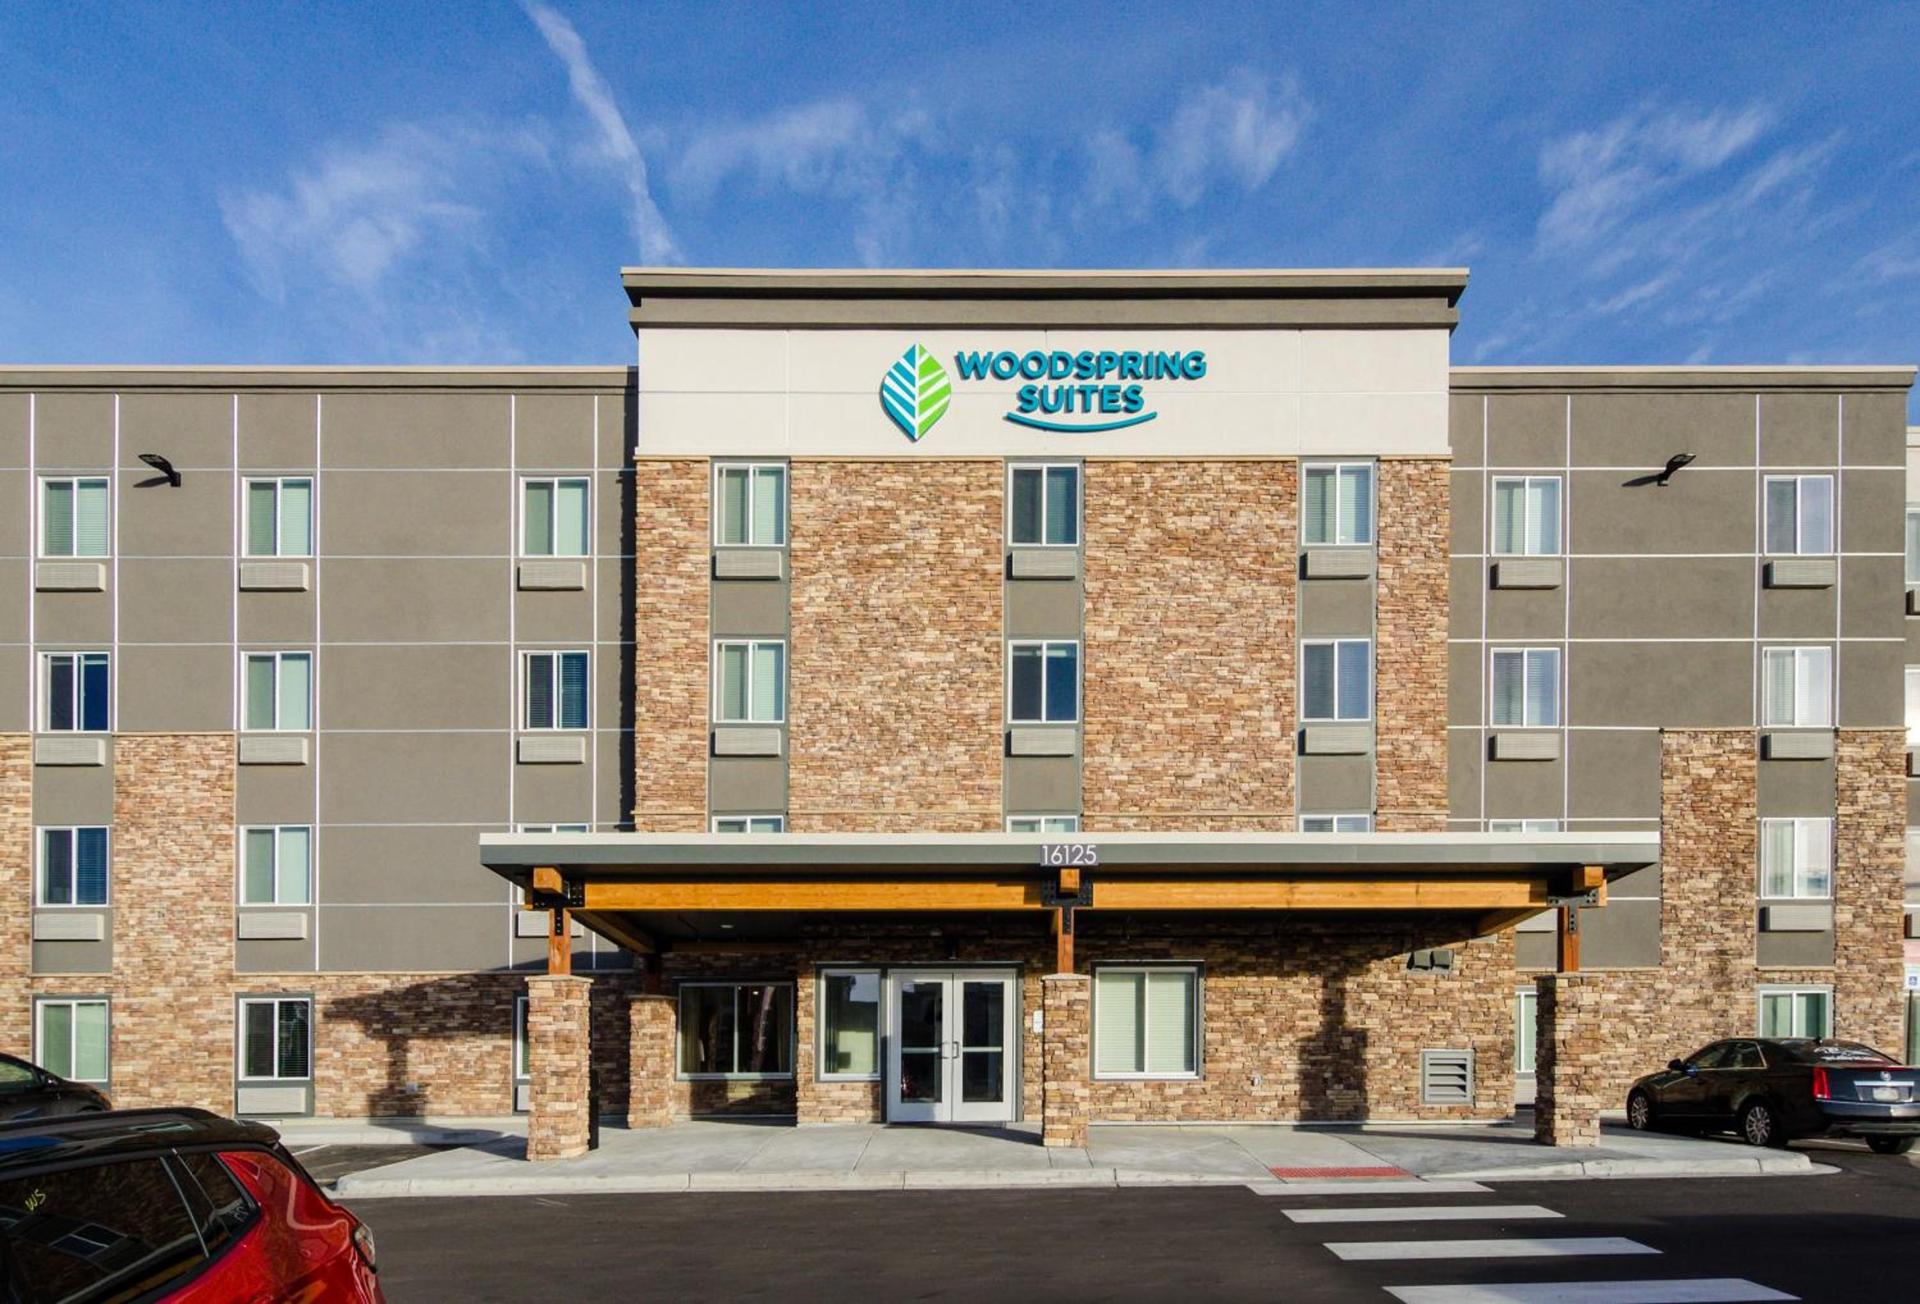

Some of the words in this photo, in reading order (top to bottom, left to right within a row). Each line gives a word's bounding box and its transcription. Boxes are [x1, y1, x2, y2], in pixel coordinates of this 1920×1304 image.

[956, 351, 1207, 380] WOODSPRING
[1017, 384, 1145, 413] SUITES
[1042, 844, 1097, 865] 16125
